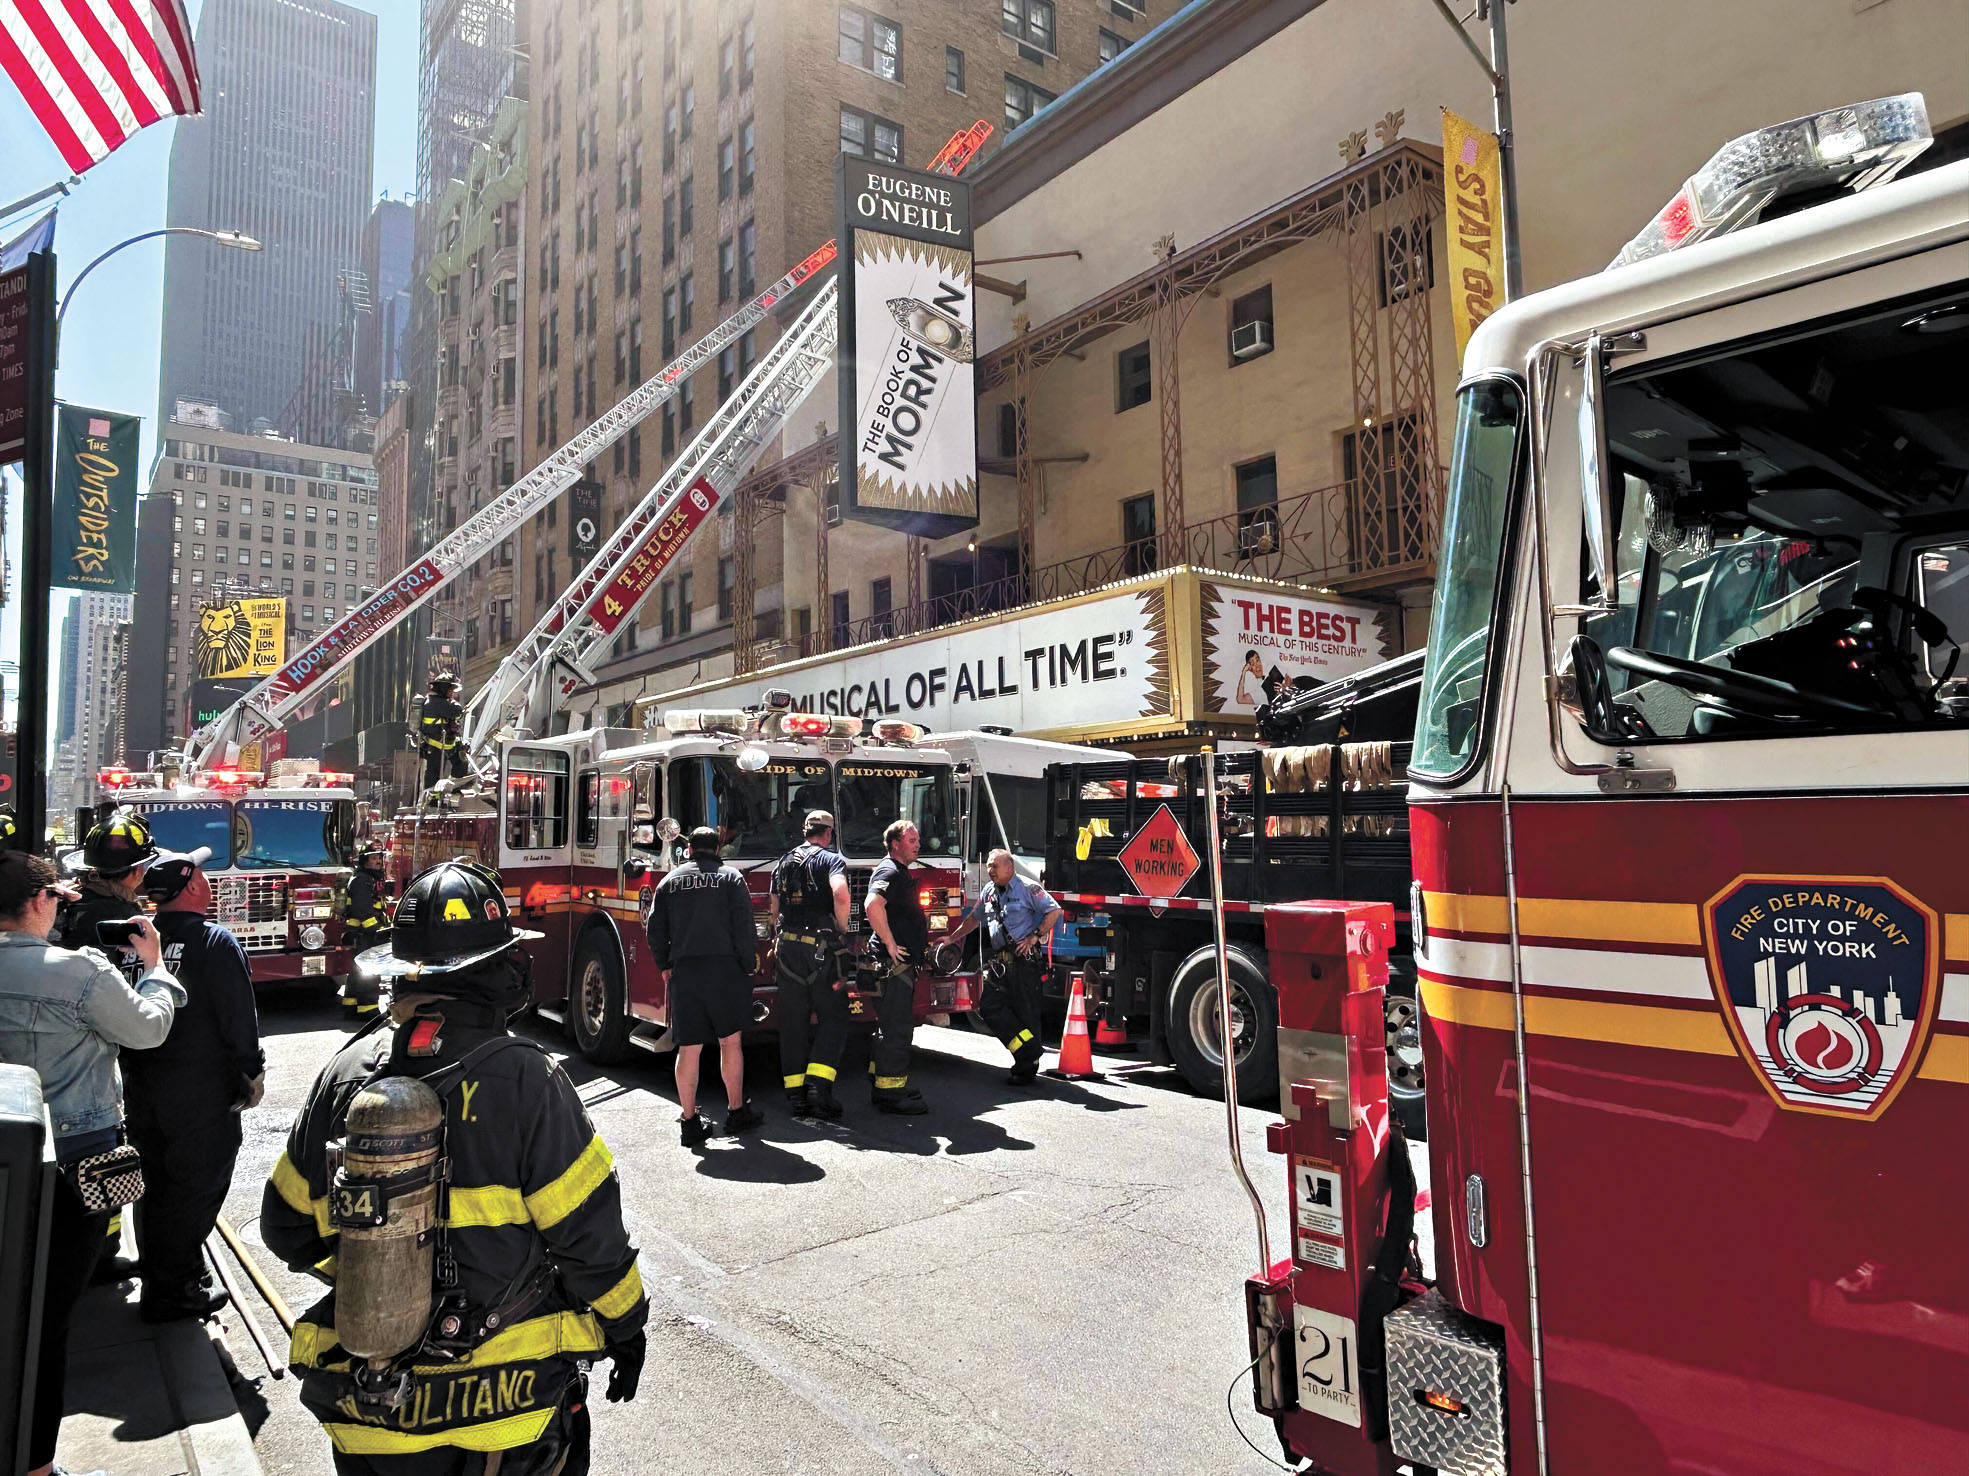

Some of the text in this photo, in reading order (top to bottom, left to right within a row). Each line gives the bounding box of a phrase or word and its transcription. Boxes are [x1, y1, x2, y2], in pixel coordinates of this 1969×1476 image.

[867, 173, 952, 206] EUGENE
[857, 192, 962, 235] O'NEILL
[1455, 164, 1494, 335] STAY GO
[2, 363, 24, 381] TIMES
[862, 336, 914, 455] THE BOOK OF
[6, 407, 24, 422] Zone
[86, 439, 110, 451] THE
[576, 489, 592, 498] THE
[72, 453, 120, 573] OUTSIDERS
[603, 505, 688, 617] 4 TRUCK
[655, 560, 664, 569] OF
[1231, 599, 1361, 644] "THE BEST
[256, 639, 275, 651] LION
[1238, 632, 1281, 648] MUSICAL
[1284, 638, 1297, 649] OF
[1299, 640, 1319, 653] THIS
[253, 653, 277, 666] KING
[287, 644, 329, 684] HOOK
[329, 635, 339, 646] &
[789, 677, 900, 717] MUSICAL
[905, 667, 948, 710] OF
[953, 656, 1019, 704] ALL
[804, 765, 826, 775] OF
[244, 801, 333, 813] HI-RISE
[1150, 838, 1174, 854] MEN
[1134, 858, 1185, 877] WORKING
[670, 872, 726, 893] FDNY
[1731, 892, 1910, 946] FIRE DEPARTMENT
[1773, 918, 1858, 936] CITY OF
[1759, 937, 1877, 959] NEW YORK
[461, 1081, 477, 1122] Y.
[340, 1191, 373, 1217] 34
[1300, 1326, 1354, 1395] 21
[336, 1370, 536, 1428] OLITANO
